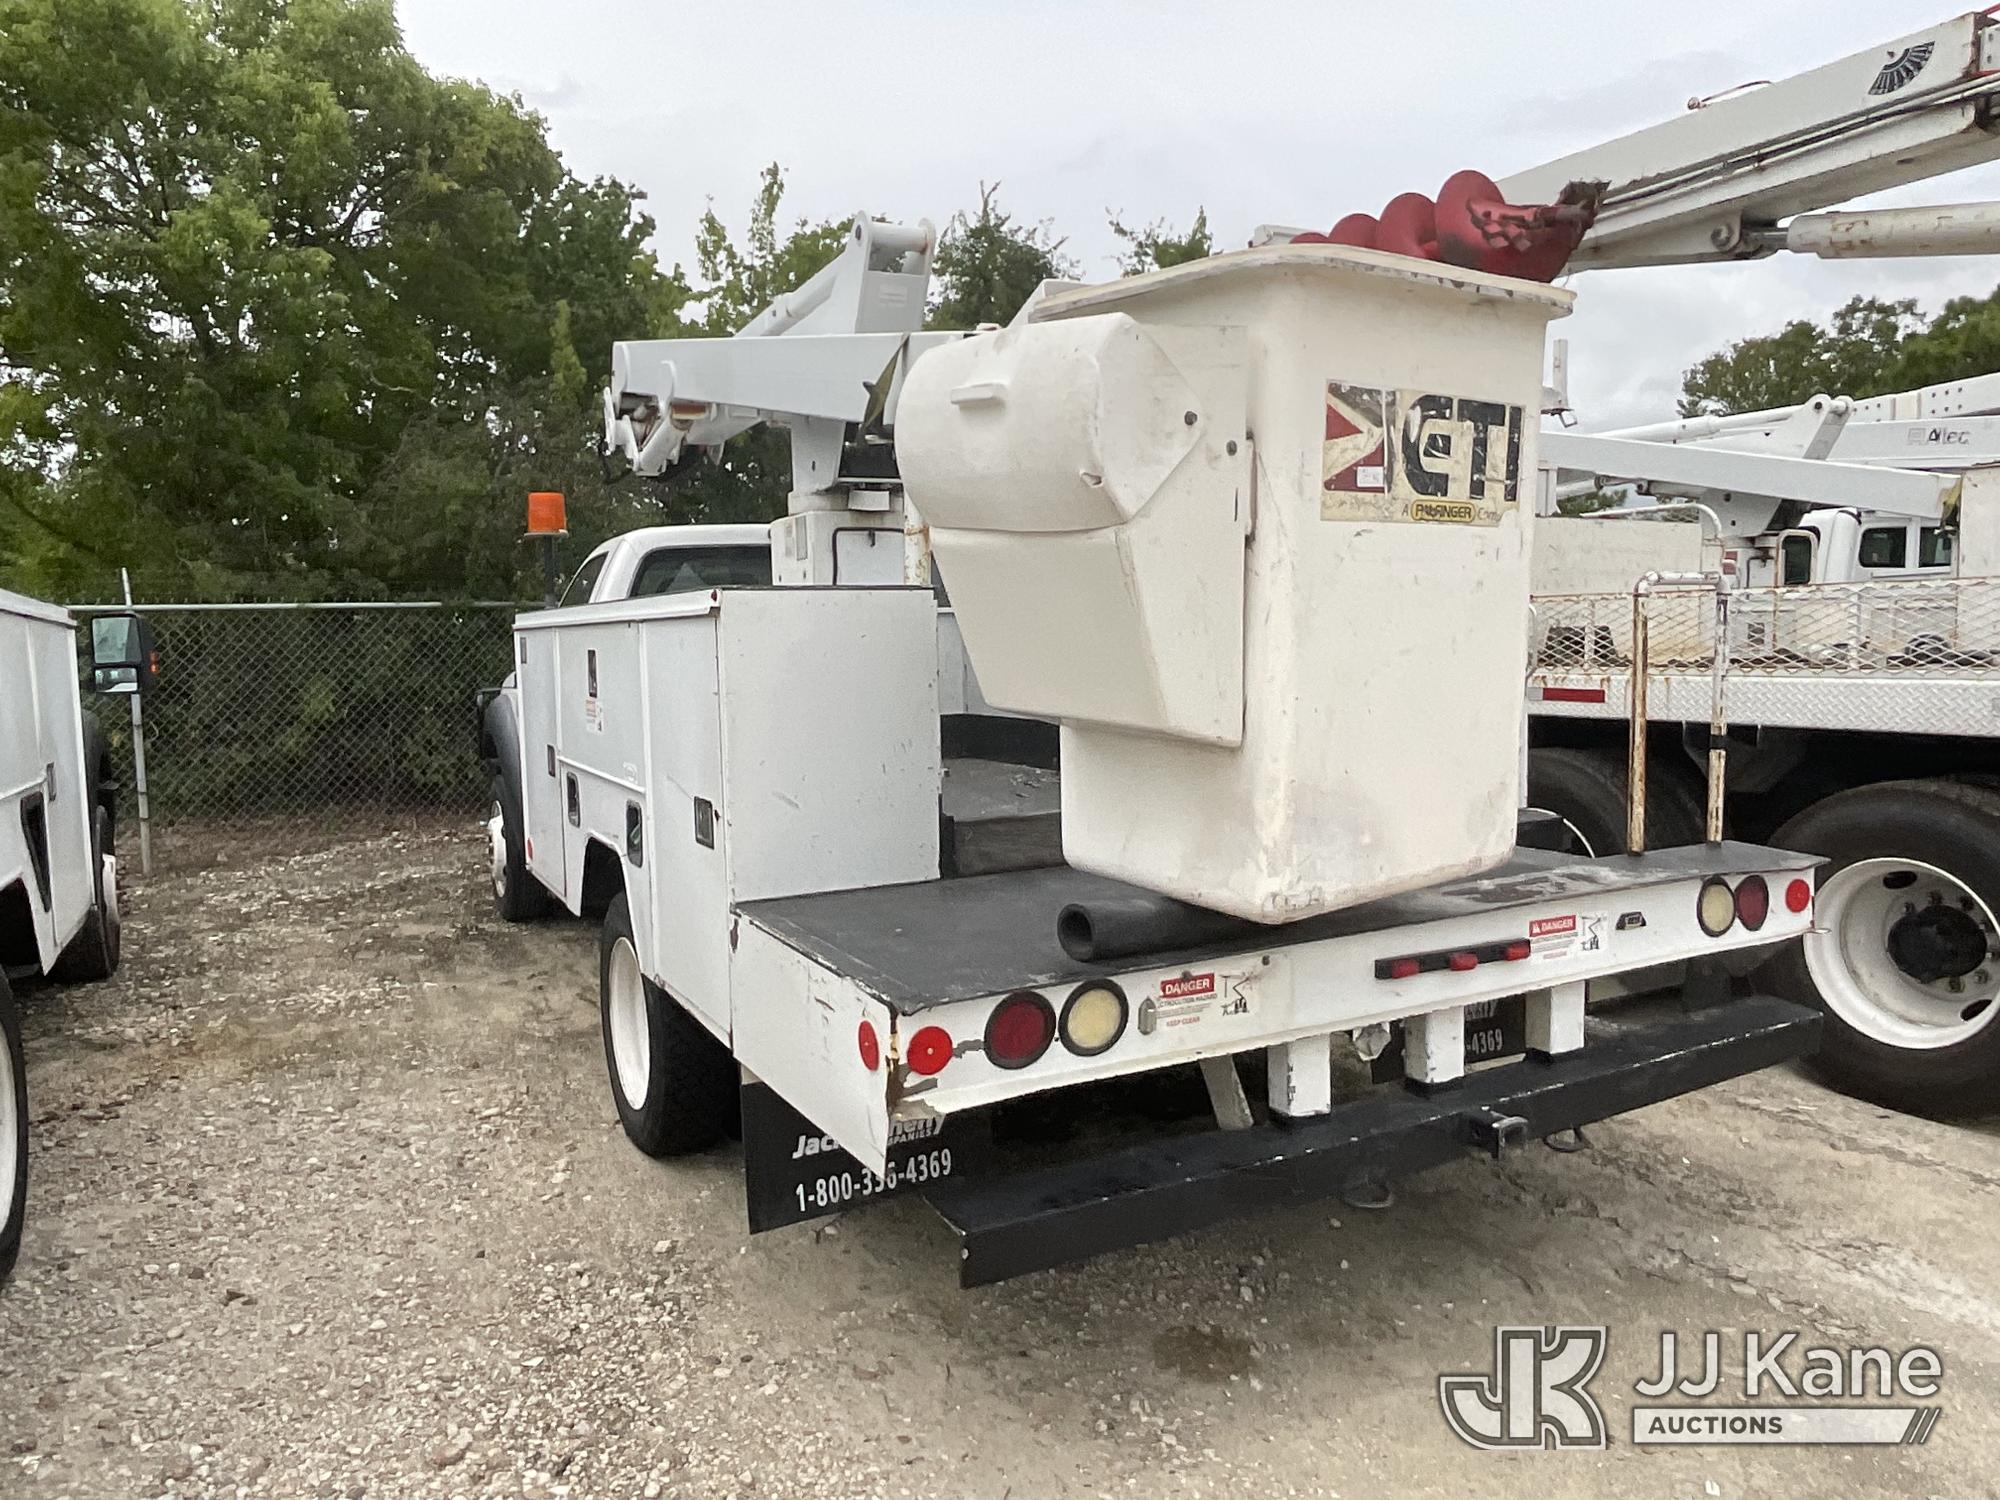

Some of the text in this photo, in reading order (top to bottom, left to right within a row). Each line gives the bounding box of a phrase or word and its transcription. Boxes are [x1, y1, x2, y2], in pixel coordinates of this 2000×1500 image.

[1541, 918, 1575, 932] DANGER
[1165, 978, 1211, 995] DANGER
[792, 1134, 840, 1159] Jac
